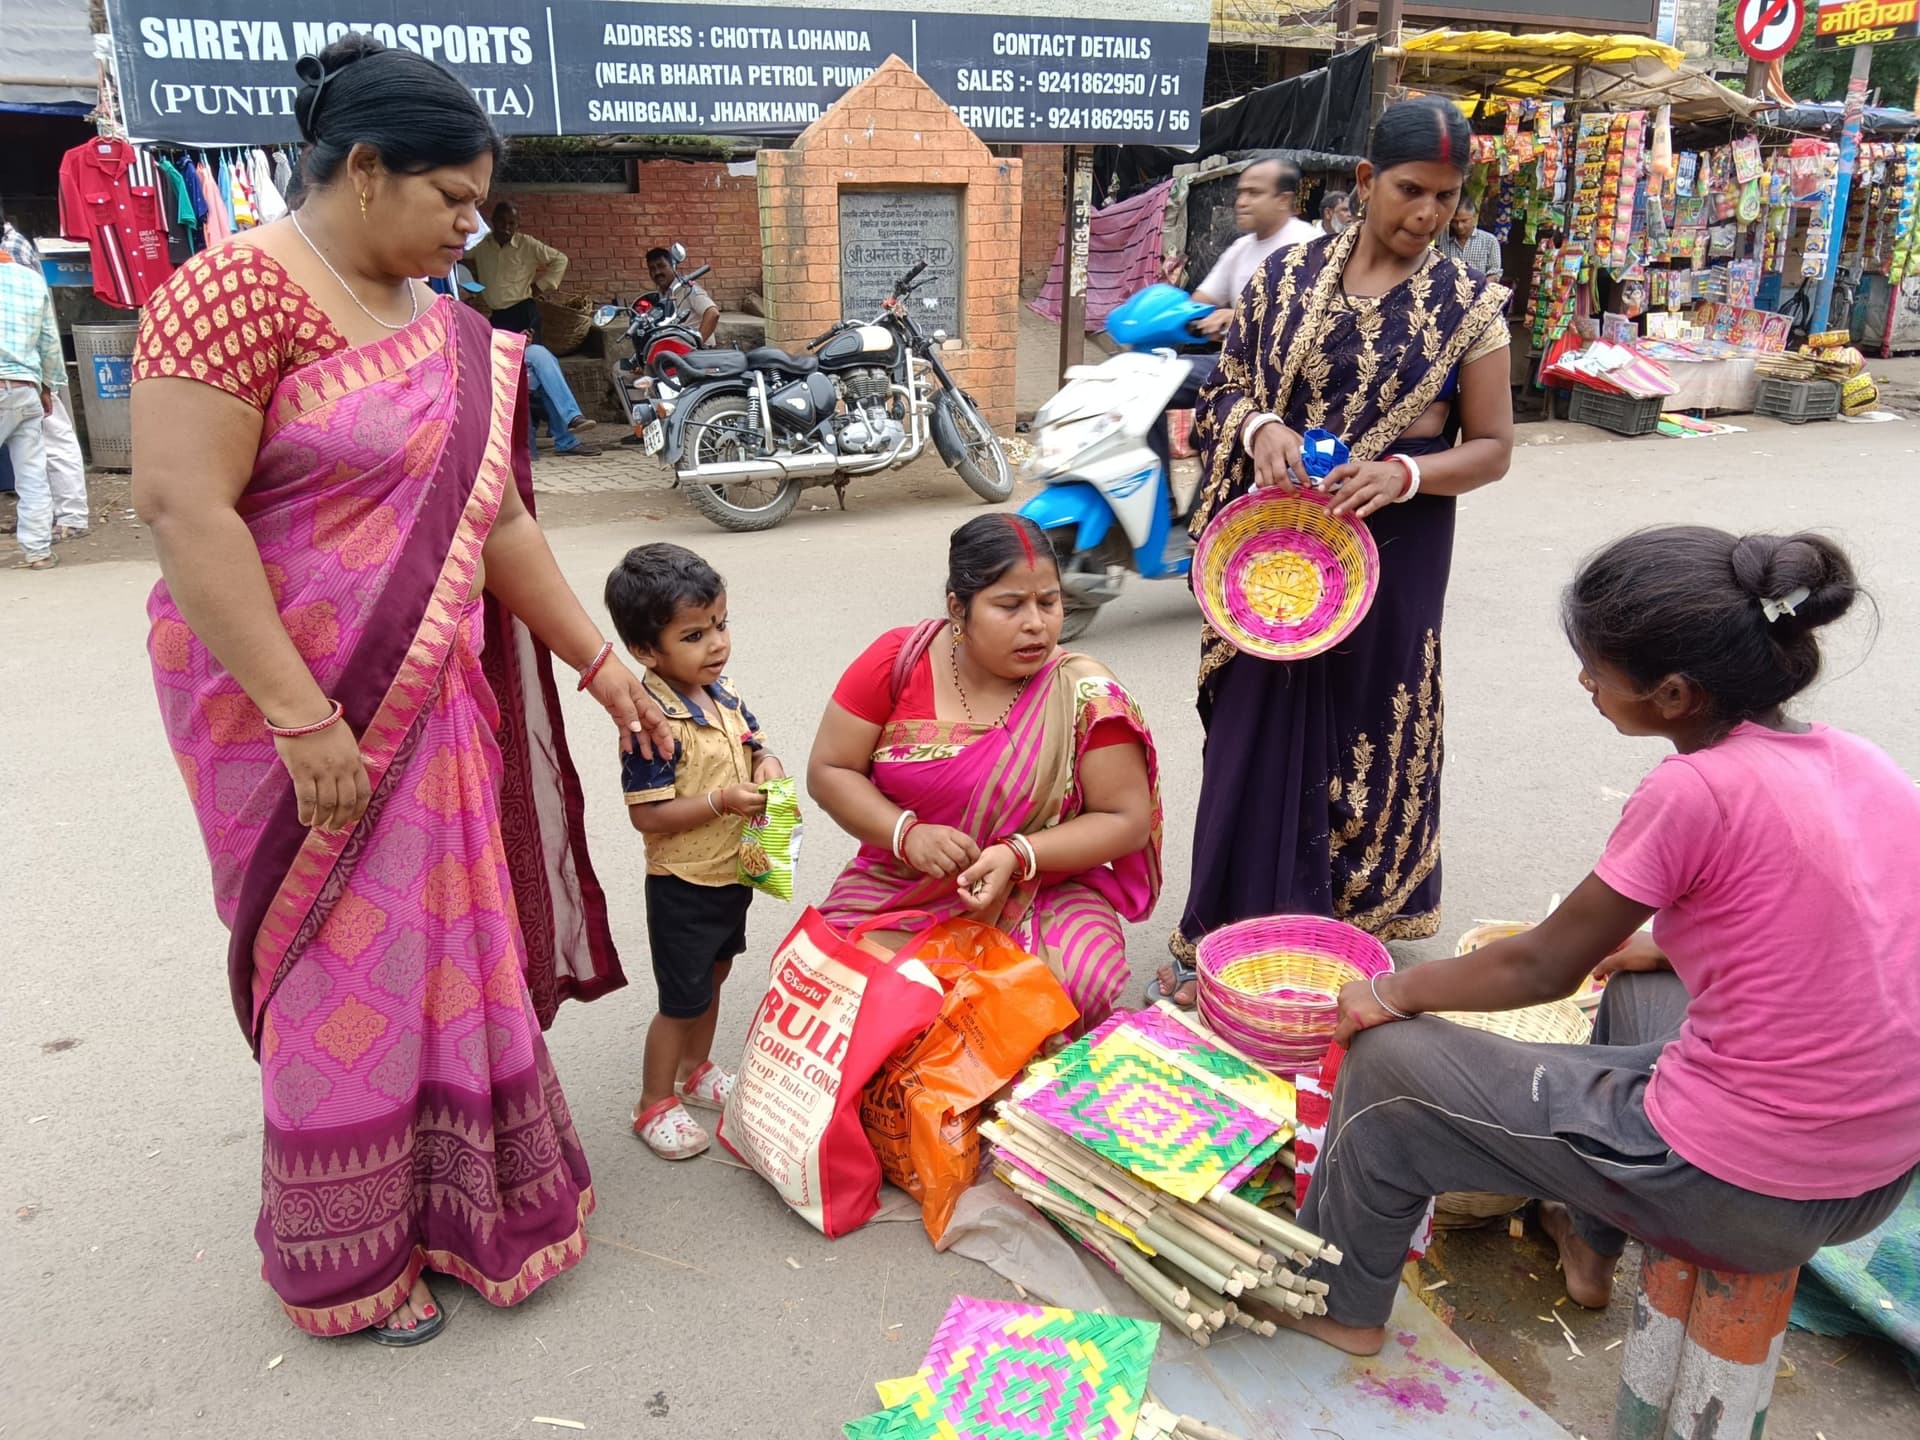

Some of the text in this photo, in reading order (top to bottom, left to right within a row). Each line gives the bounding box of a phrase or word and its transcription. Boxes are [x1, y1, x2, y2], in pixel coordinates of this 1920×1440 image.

[139, 16, 289, 61] SHREYA
[603, 24, 692, 47] ADDRESS
[711, 26, 783, 50] CHOTTA
[788, 29, 871, 51] LOHANDA
[993, 32, 1151, 60] CONTACT DETAILS
[1836, 28, 1898, 46] स्टील
[595, 62, 878, 88] (NEAR BHARTIA PETROL PUMP
[957, 69, 1014, 92] SALES
[1038, 71, 1145, 95] 9241862950
[1161, 75, 1181, 96] 51
[588, 99, 835, 125] SAHIBGANJ, JHARKHAND-
[1048, 108, 1153, 130] 9241862955
[1169, 110, 1190, 131] 56
[763, 986, 850, 1071] BULE
